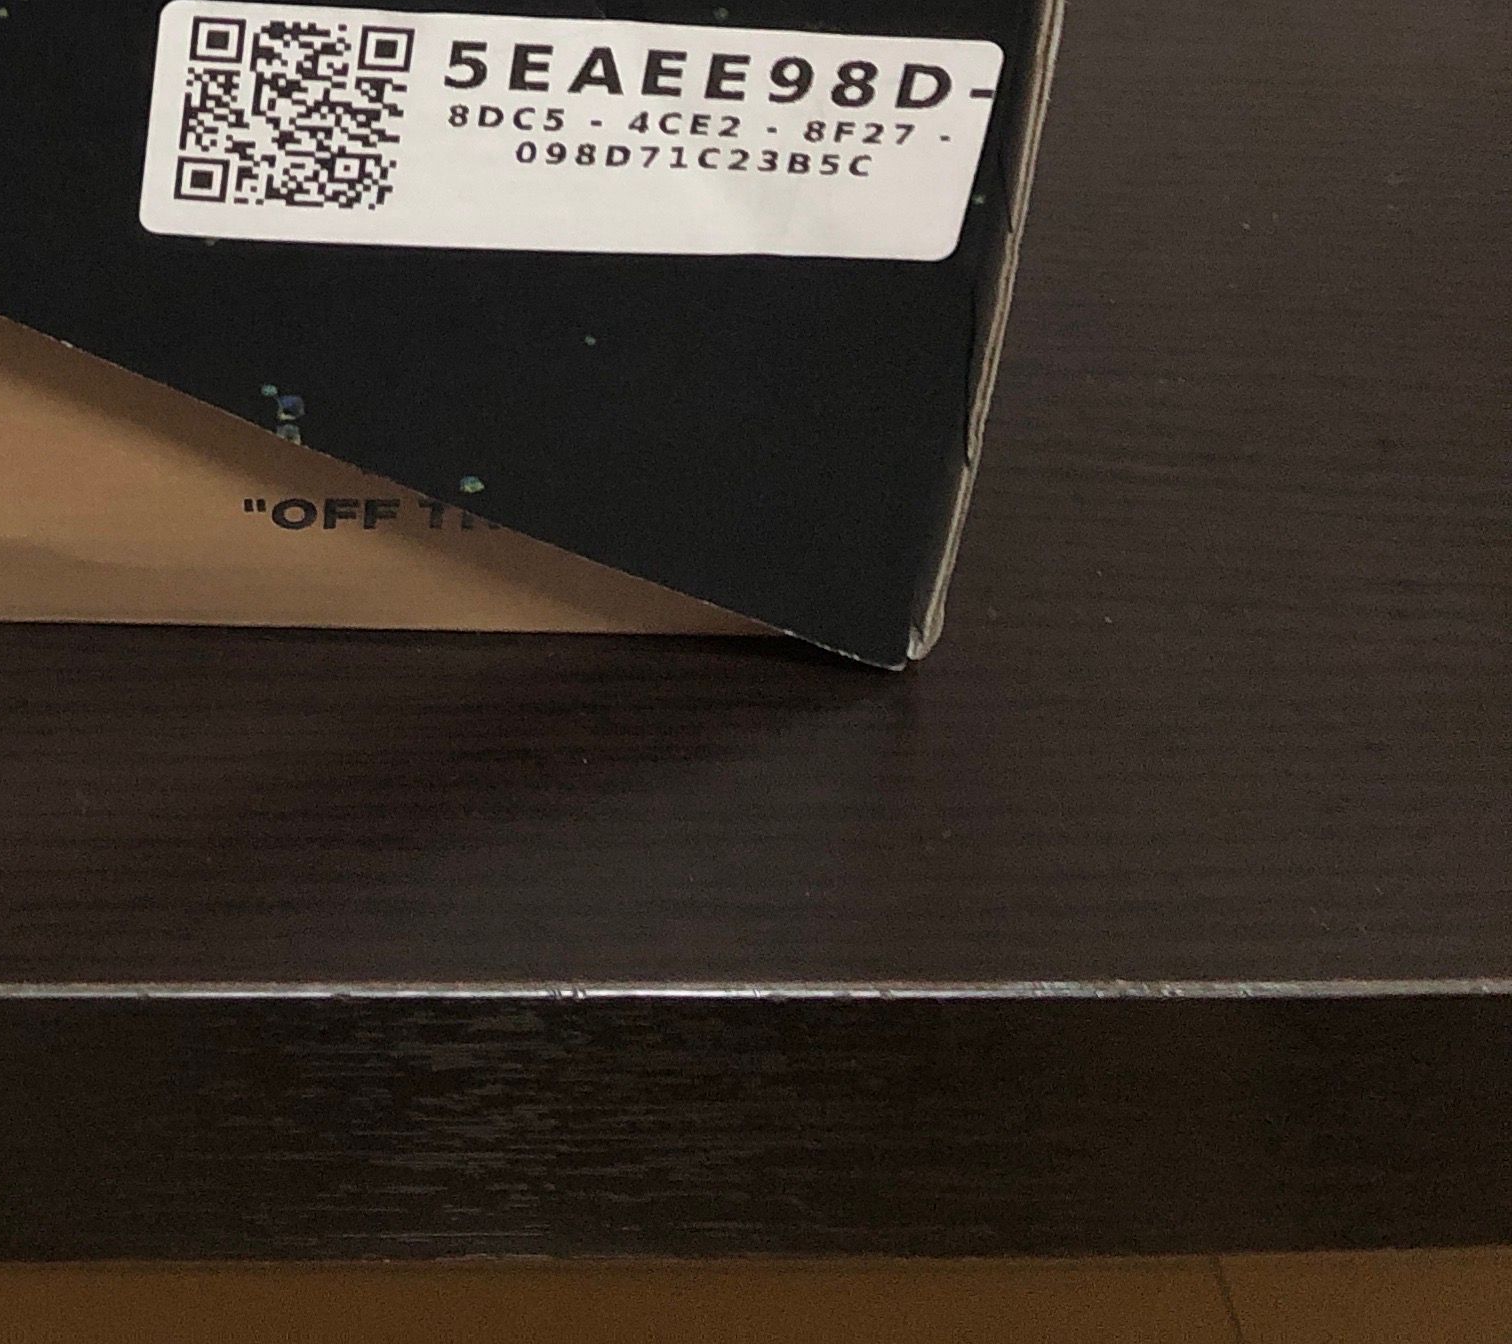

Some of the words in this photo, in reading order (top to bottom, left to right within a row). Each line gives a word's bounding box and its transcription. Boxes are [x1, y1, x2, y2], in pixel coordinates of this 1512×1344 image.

[443, 40, 996, 110] 5EAEE98D-
[515, 141, 874, 178] 098D71C23B5C
[244, 498, 400, 530] "OFF
